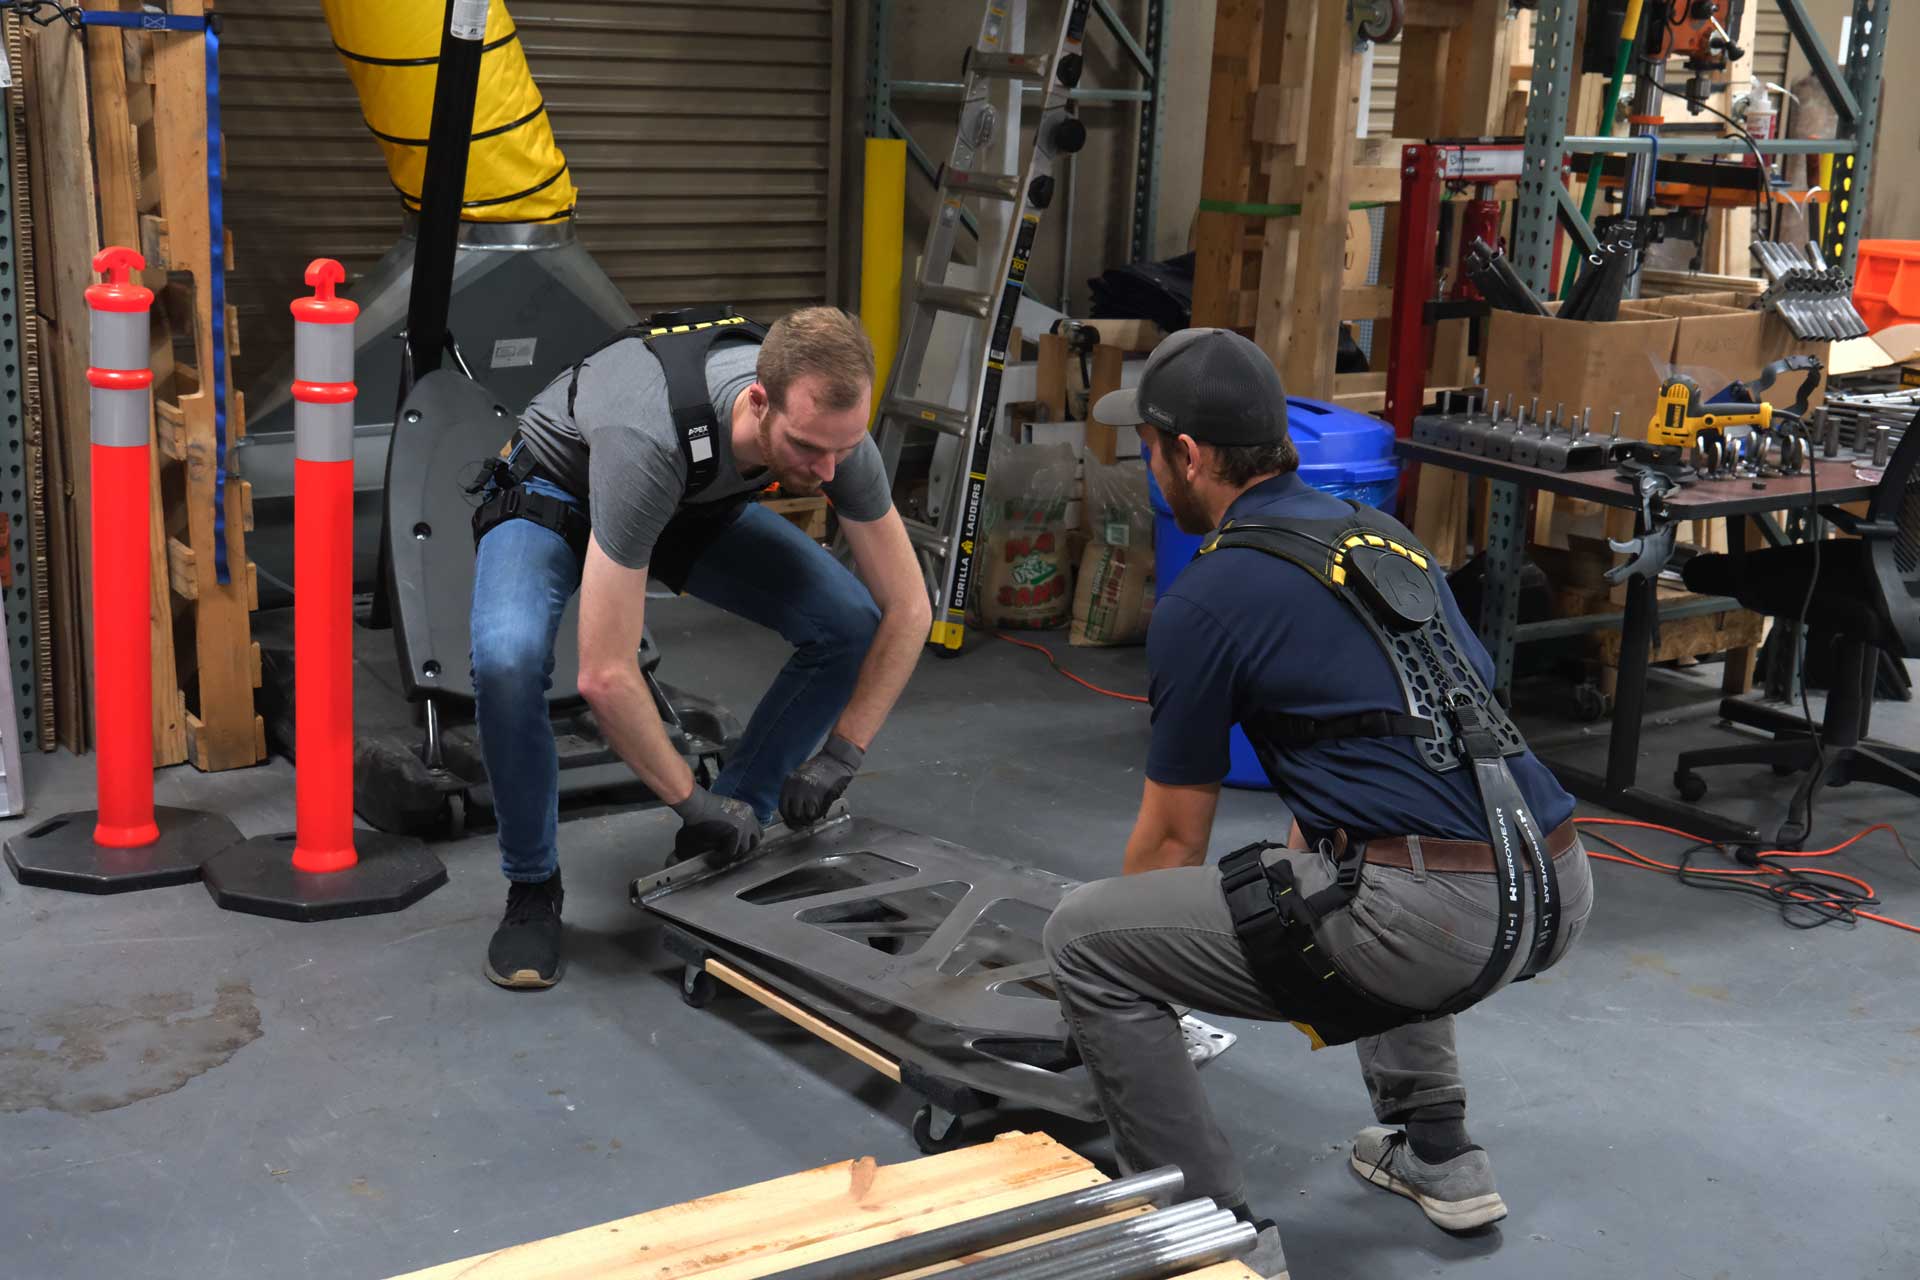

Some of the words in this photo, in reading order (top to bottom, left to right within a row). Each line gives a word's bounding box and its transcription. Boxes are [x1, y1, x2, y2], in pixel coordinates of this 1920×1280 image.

[688, 425, 707, 436] APEX
[954, 557, 970, 607] GORILLA
[966, 483, 981, 537] LADDERS
[1496, 807, 1517, 886] HEROWEAR
[1523, 823, 1550, 903] HEROWEAR
